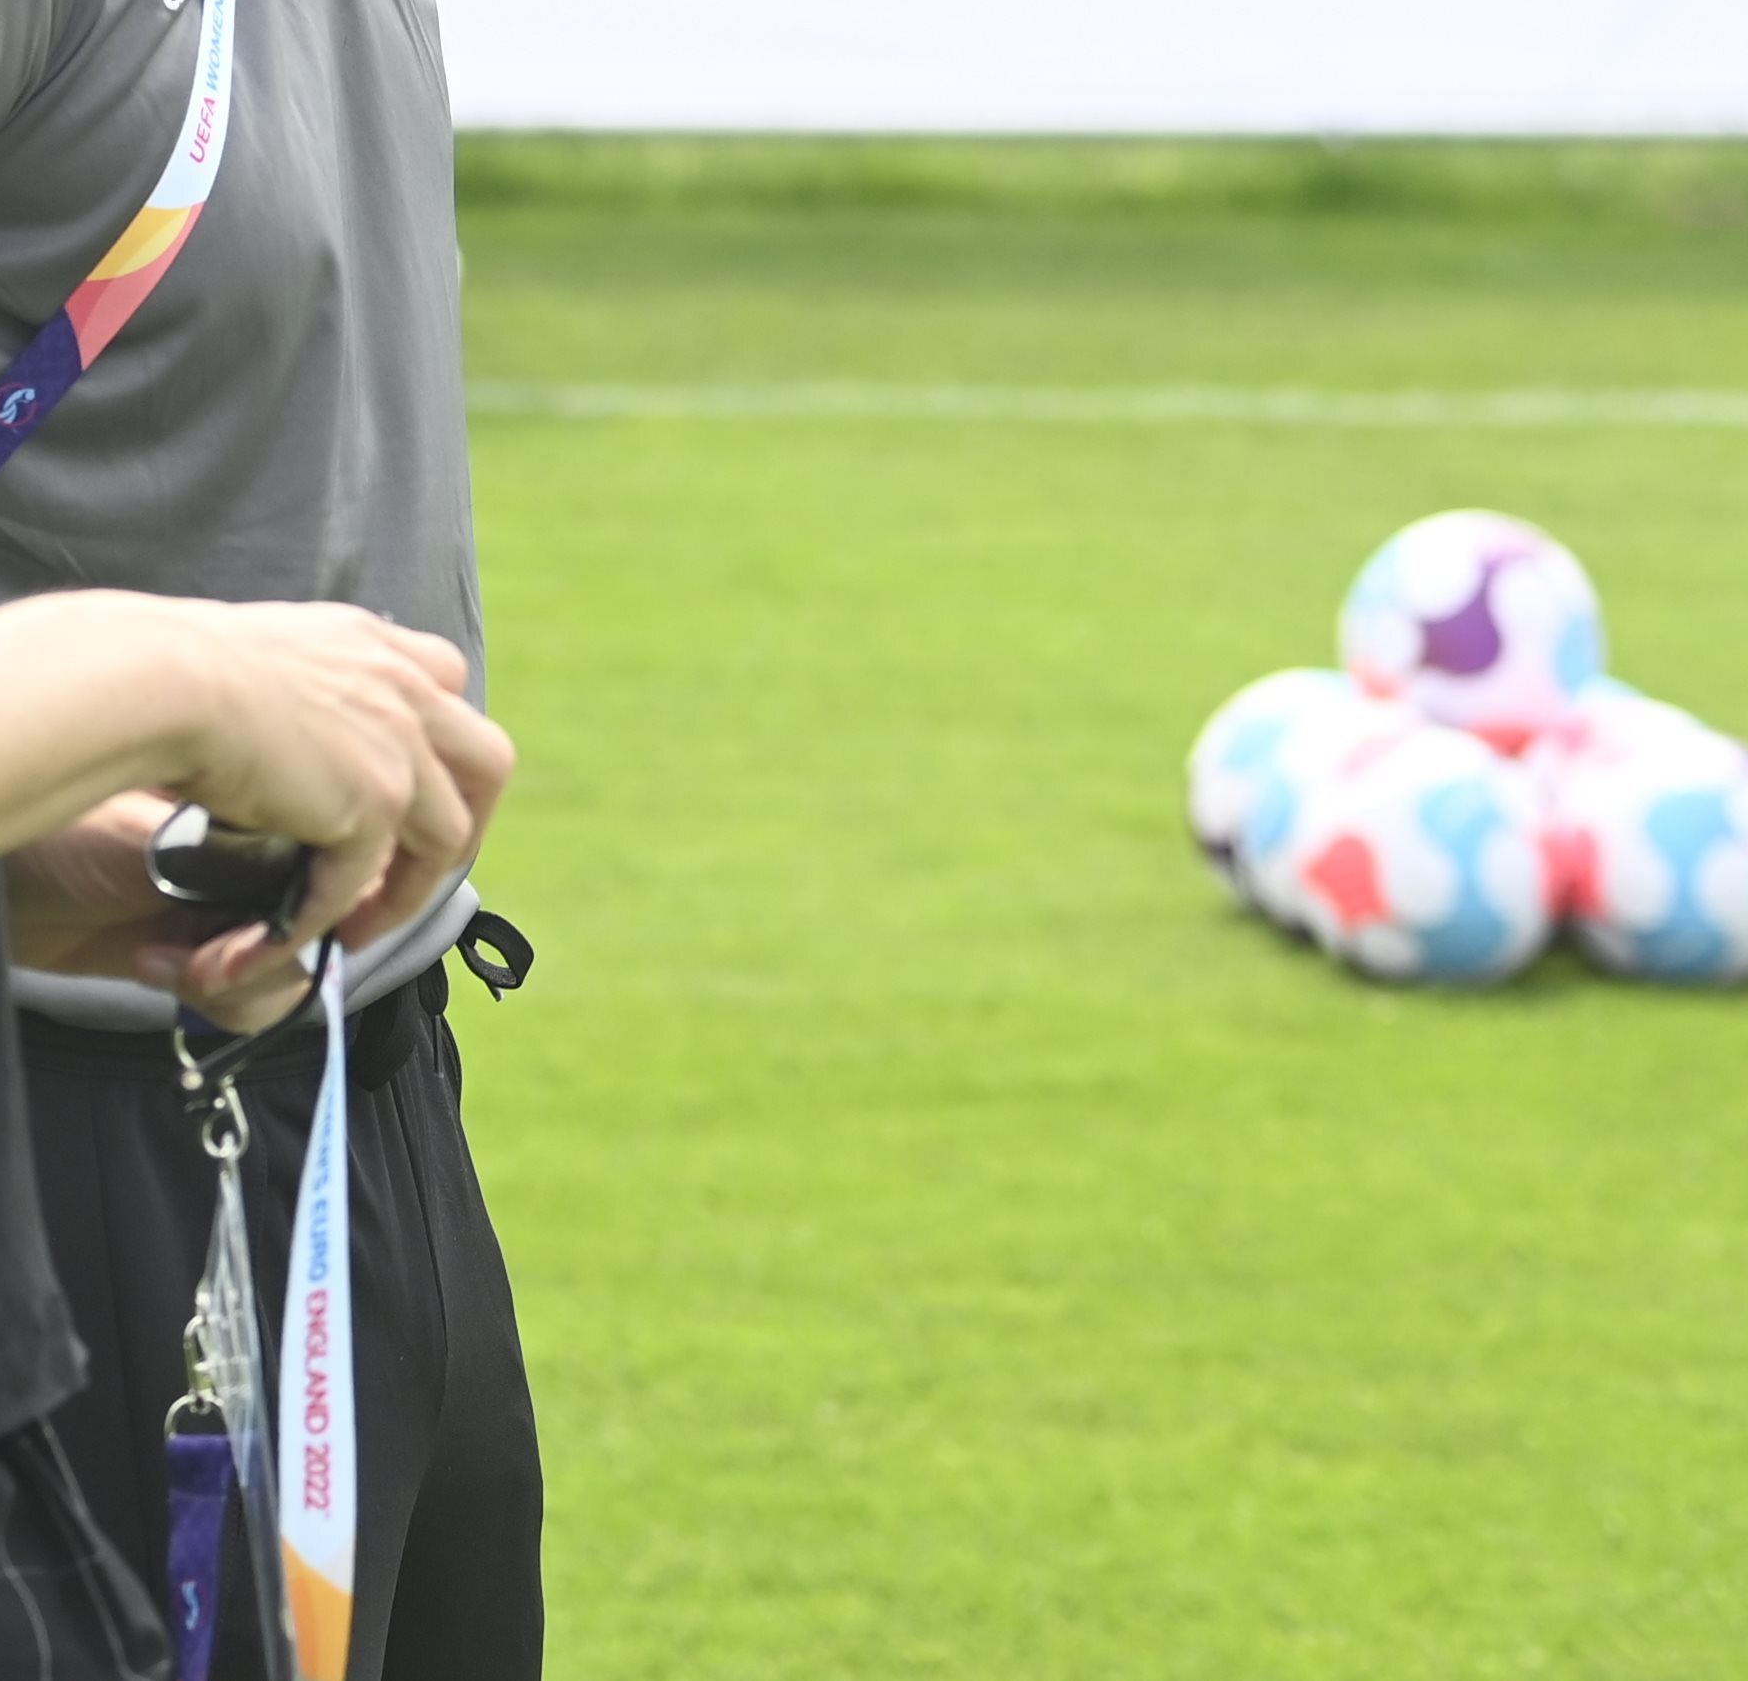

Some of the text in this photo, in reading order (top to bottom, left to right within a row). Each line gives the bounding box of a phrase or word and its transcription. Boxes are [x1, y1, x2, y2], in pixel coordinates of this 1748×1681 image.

[189, 97, 216, 164] UEFA
[308, 1198, 328, 1282] EURO
[305, 1289, 329, 1435] ENGLAND
[305, 1443, 330, 1512] 2022
